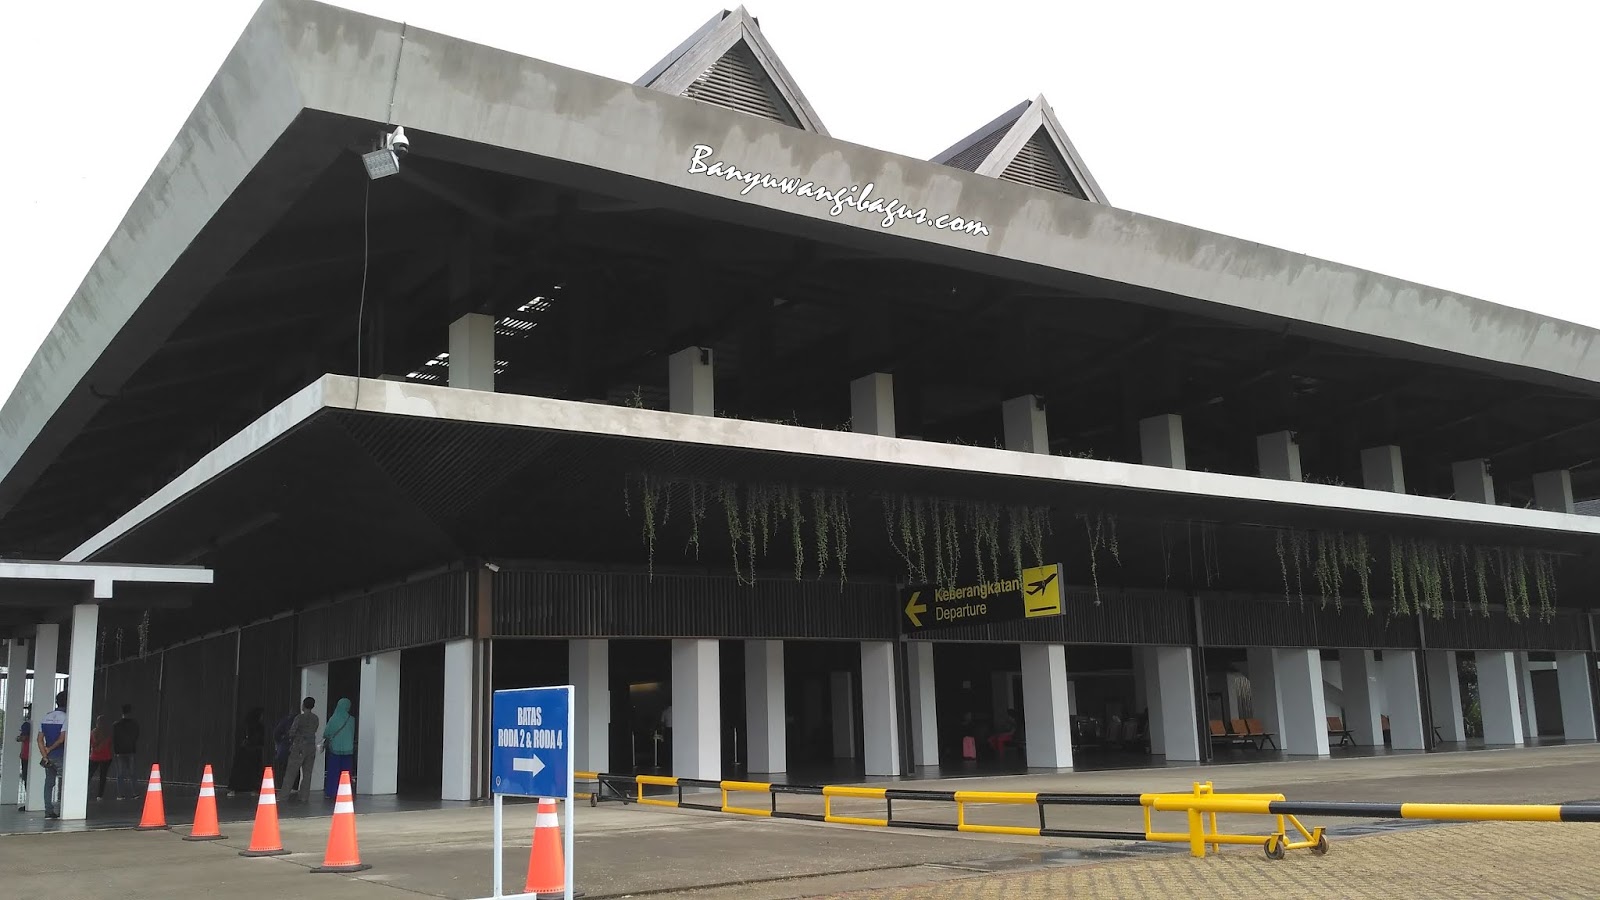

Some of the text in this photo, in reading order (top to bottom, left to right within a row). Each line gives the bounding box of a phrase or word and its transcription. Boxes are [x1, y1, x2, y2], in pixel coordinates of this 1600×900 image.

[934, 578, 1020, 602] Keberangkatan
[935, 603, 988, 622] Departure
[517, 707, 542, 726] BATAS
[498, 729, 563, 749] RODA 2 & RODA 4
